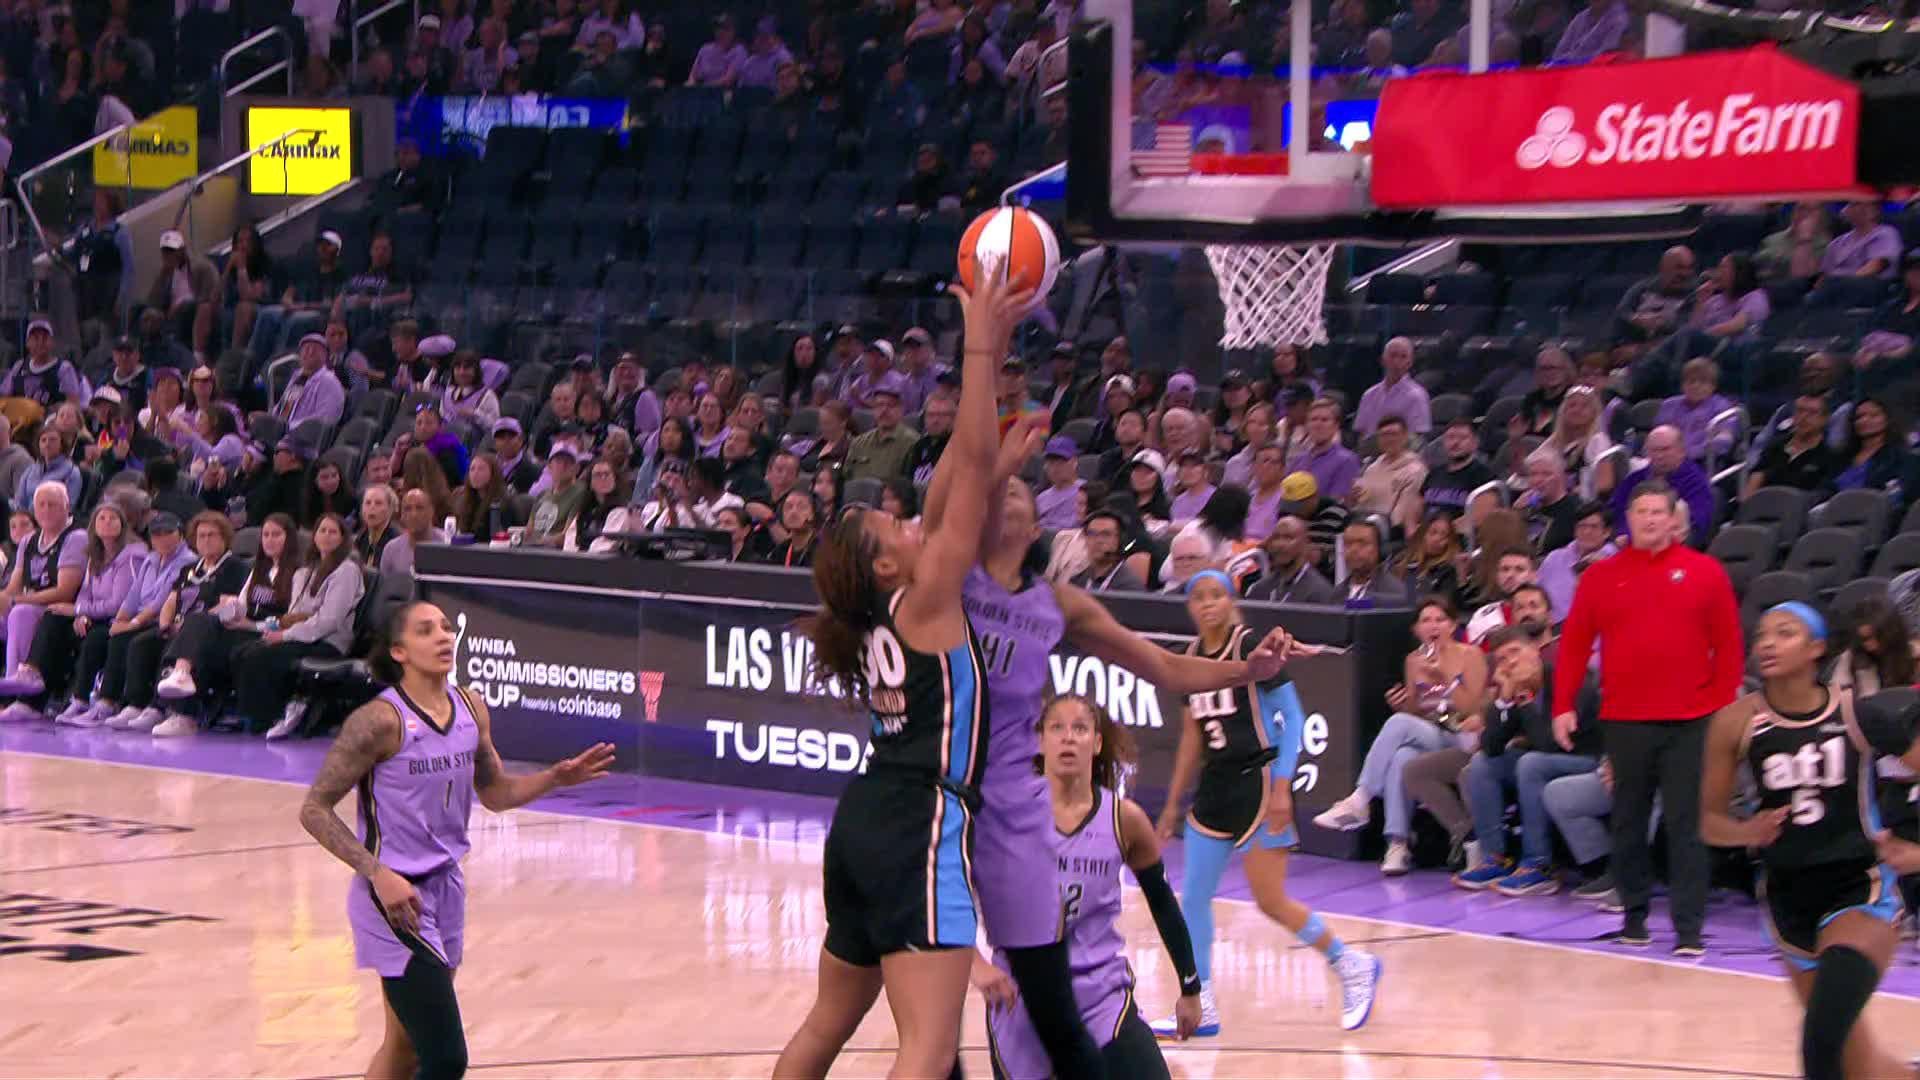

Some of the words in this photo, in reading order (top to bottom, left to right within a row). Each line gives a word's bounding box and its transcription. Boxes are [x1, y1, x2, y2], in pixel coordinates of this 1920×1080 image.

[467, 636, 516, 656] WNBA
[706, 624, 773, 692] LAS
[980, 633, 1017, 677] 41
[467, 656, 636, 695] COMMISSIONER'S
[1049, 653, 1164, 729] YORK
[468, 681, 521, 709] CUP
[558, 693, 622, 720] coinbase
[1204, 719, 1228, 750] 3
[408, 755, 452, 776] GOLDEN
[445, 779, 455, 809] 1
[1791, 788, 1826, 826] 5
[1073, 857, 1110, 877] STATE
[1059, 881, 1083, 918] 2
